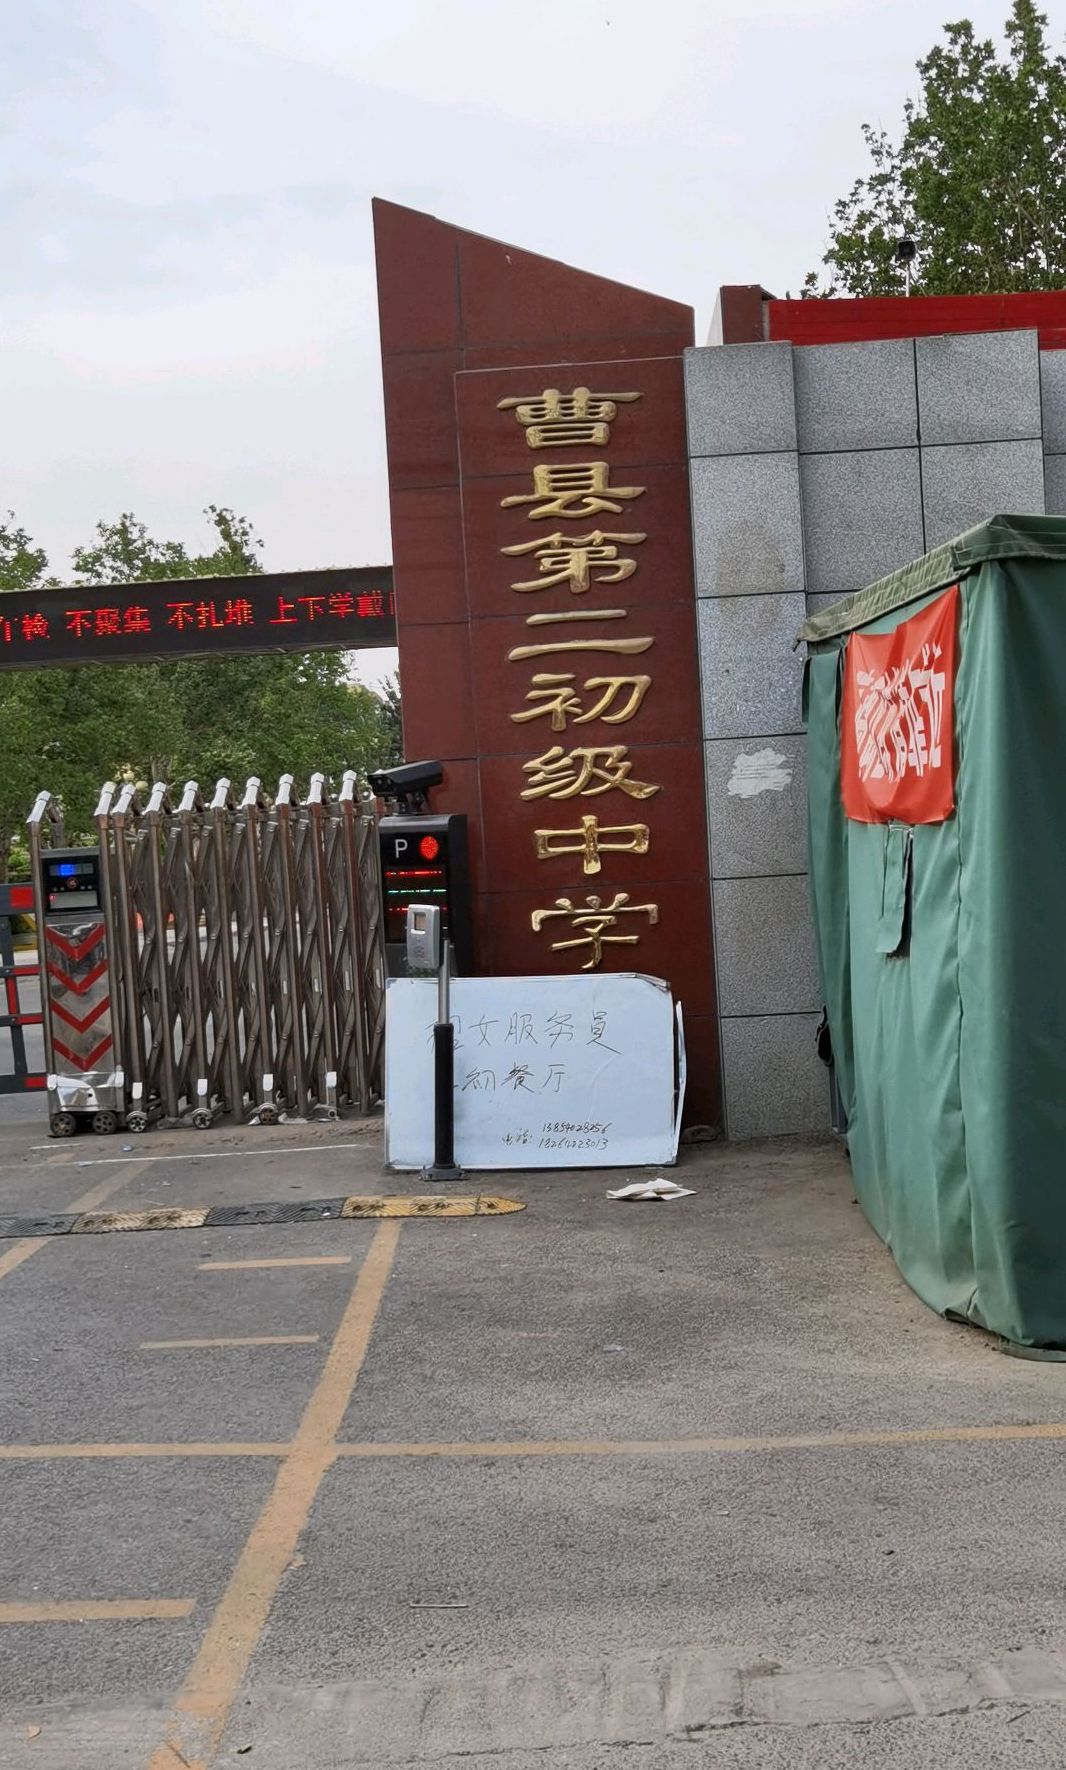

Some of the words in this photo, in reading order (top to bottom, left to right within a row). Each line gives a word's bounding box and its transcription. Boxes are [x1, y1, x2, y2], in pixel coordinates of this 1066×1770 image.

[66, 605, 153, 637] 不聚集
[165, 598, 255, 630] 不扎堆
[497, 386, 664, 969] 曹县第二初级中学
[394, 838, 408, 859] P
